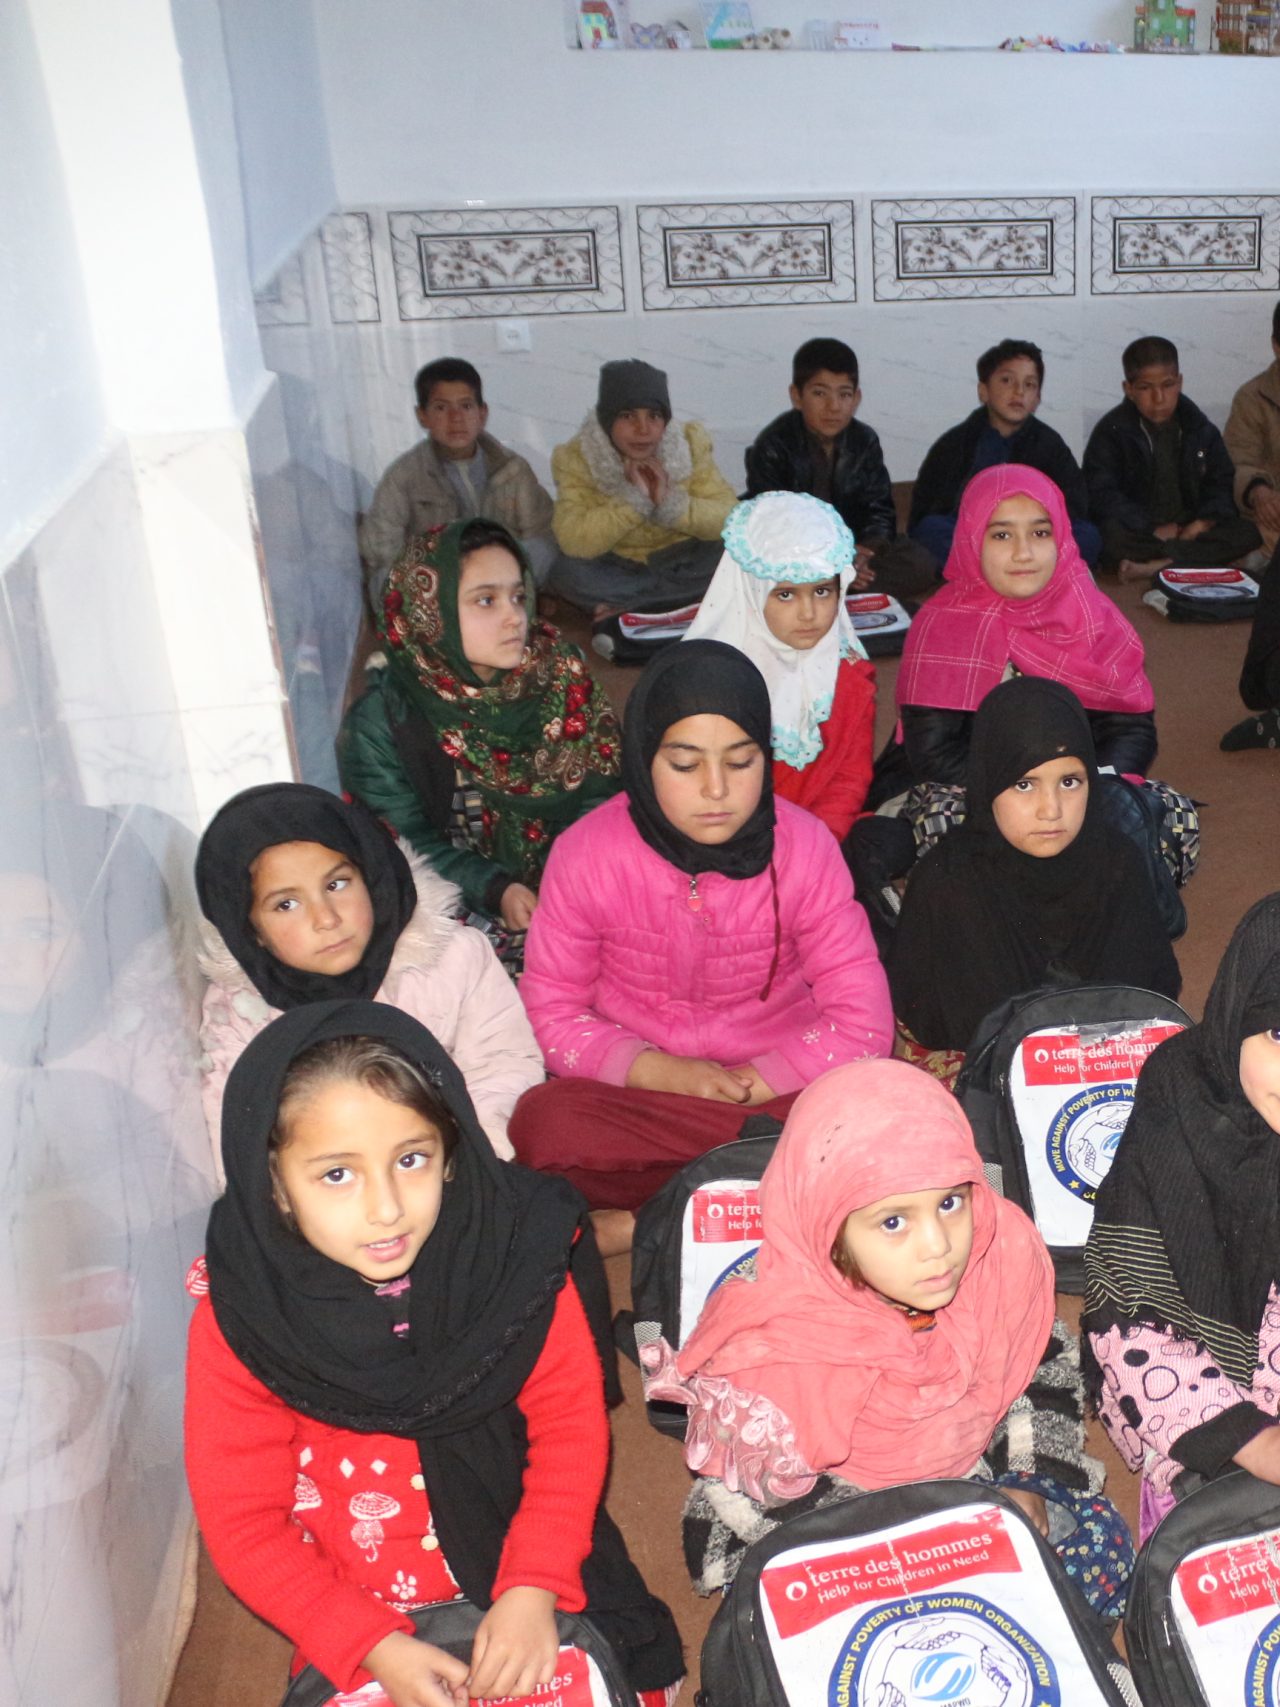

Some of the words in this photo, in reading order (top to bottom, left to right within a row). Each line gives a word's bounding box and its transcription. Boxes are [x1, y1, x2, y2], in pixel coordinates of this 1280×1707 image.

[1054, 1063, 1075, 1074] Help
[1094, 1059, 1130, 1071] Children
[1068, 1091, 1105, 1115] POVERTY
[1107, 1089, 1121, 1097] OF
[1052, 1112, 1070, 1148] AGAINST
[1052, 1149, 1066, 1172] MOVE
[728, 1220, 752, 1230] Help
[809, 1563, 861, 1587] terre
[865, 1556, 901, 1577] des
[903, 1533, 993, 1565] hommes
[1220, 1558, 1269, 1584] terre
[817, 1583, 850, 1604] Help
[854, 1578, 873, 1592] for
[876, 1565, 936, 1588] Children
[938, 1560, 951, 1574] in
[953, 1549, 990, 1569] Need
[1230, 1580, 1260, 1601] Help
[851, 1606, 902, 1652] POVERTY
[904, 1602, 924, 1614] OF
[927, 1597, 984, 1613] WOMEN
[985, 1610, 1051, 1687] ORGANIZATION
[1253, 1651, 1271, 1707] AGAINST
